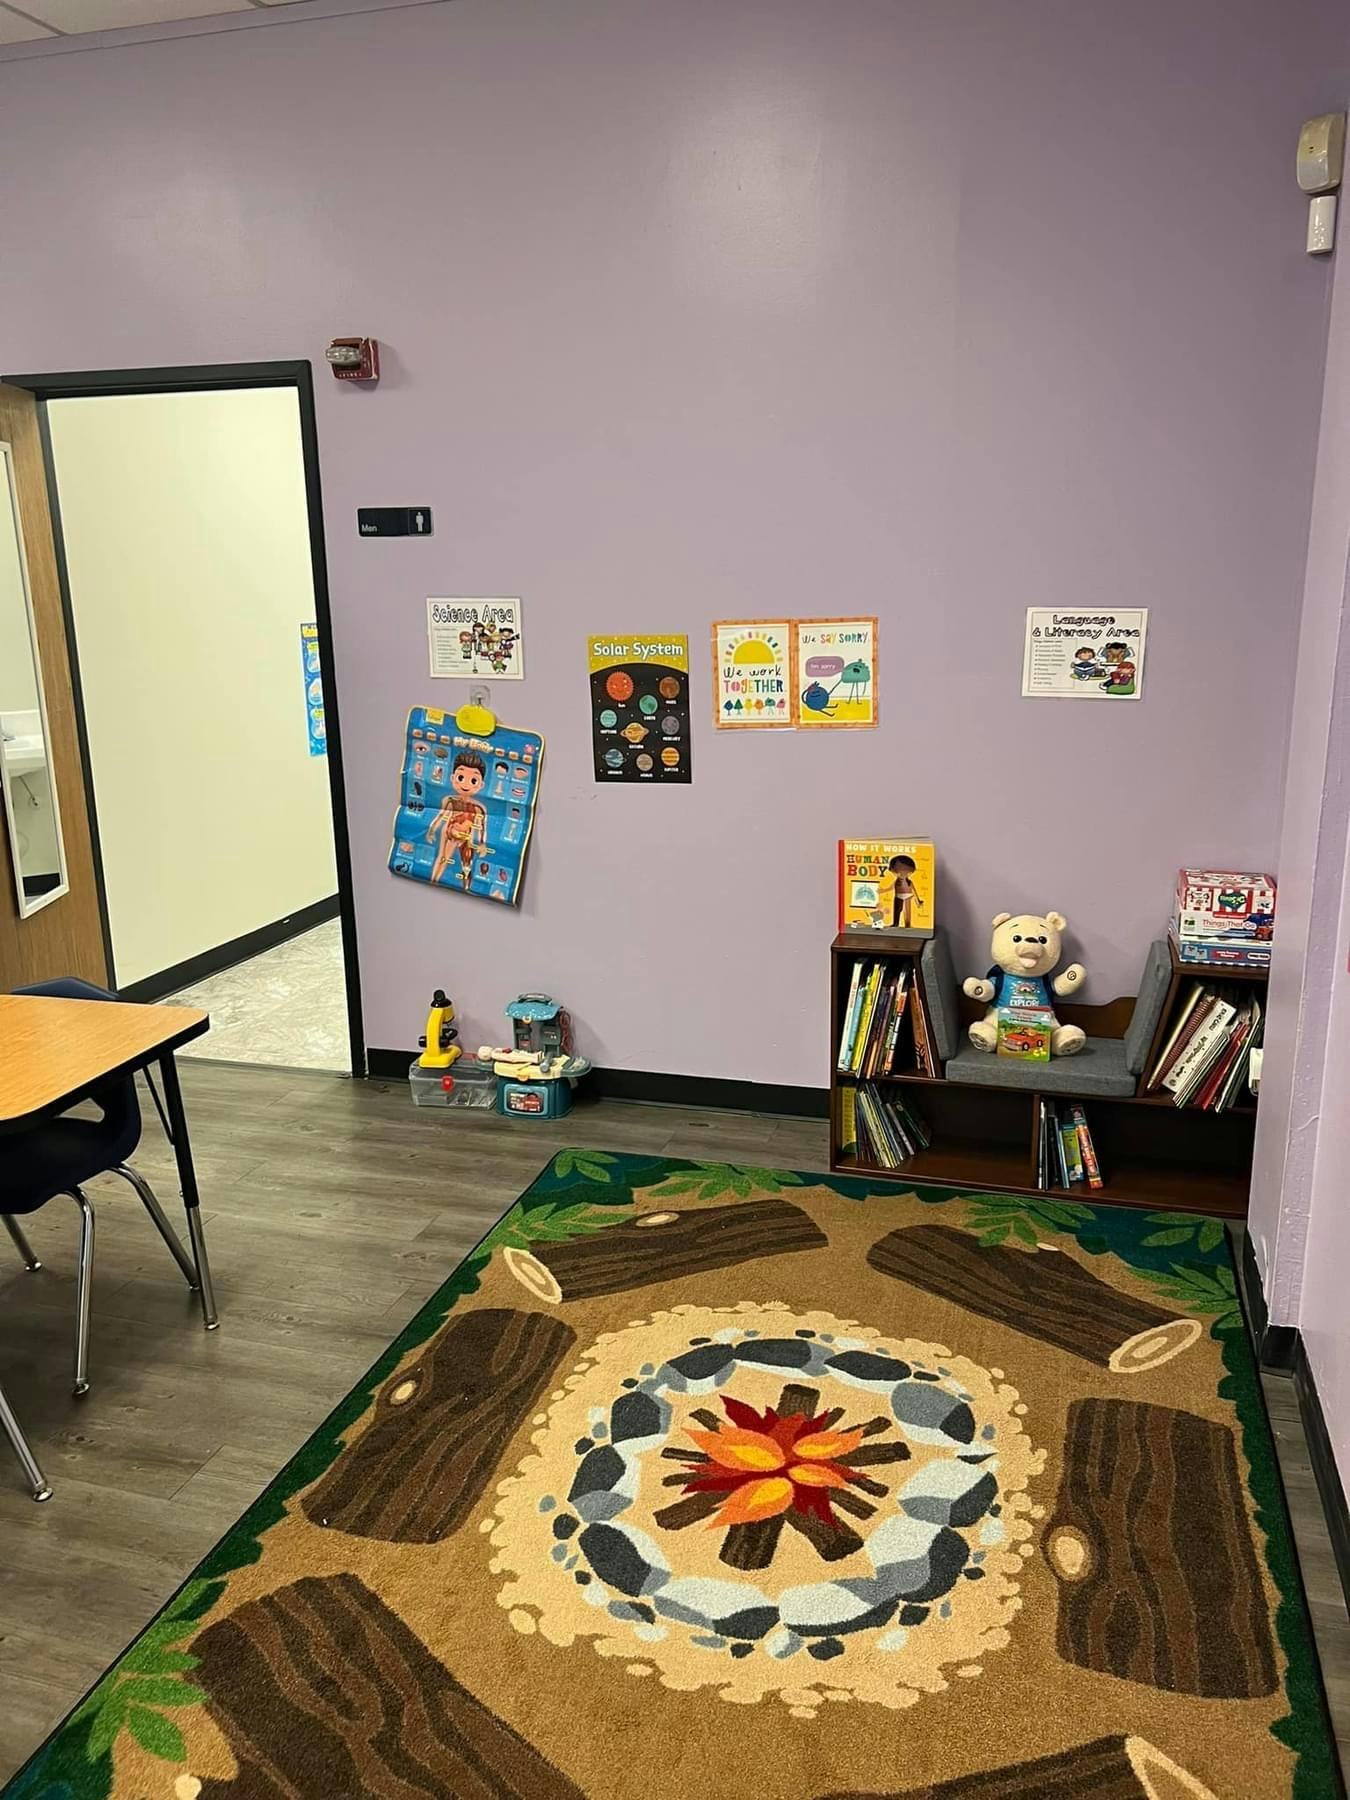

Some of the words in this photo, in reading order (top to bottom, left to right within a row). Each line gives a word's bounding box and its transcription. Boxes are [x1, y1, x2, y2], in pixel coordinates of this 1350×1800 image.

[361, 523, 378, 532] Men
[432, 604, 479, 624] Science
[481, 604, 514, 624] Area
[1052, 614, 1116, 627] Language
[802, 634, 816, 644] We
[838, 632, 869, 644] SORRY
[1032, 627, 1041, 637] &
[1044, 627, 1103, 640] Literacy
[1106, 627, 1140, 638] Area
[593, 642, 630, 656] Solar
[632, 642, 684, 661] System
[723, 666, 743, 678] We
[749, 664, 782, 676] work
[846, 843, 868, 852] HOW
[870, 844, 881, 852] IT
[883, 845, 917, 854] WORKS
[846, 854, 890, 865] HUMAN
[847, 864, 888, 877] BODY
